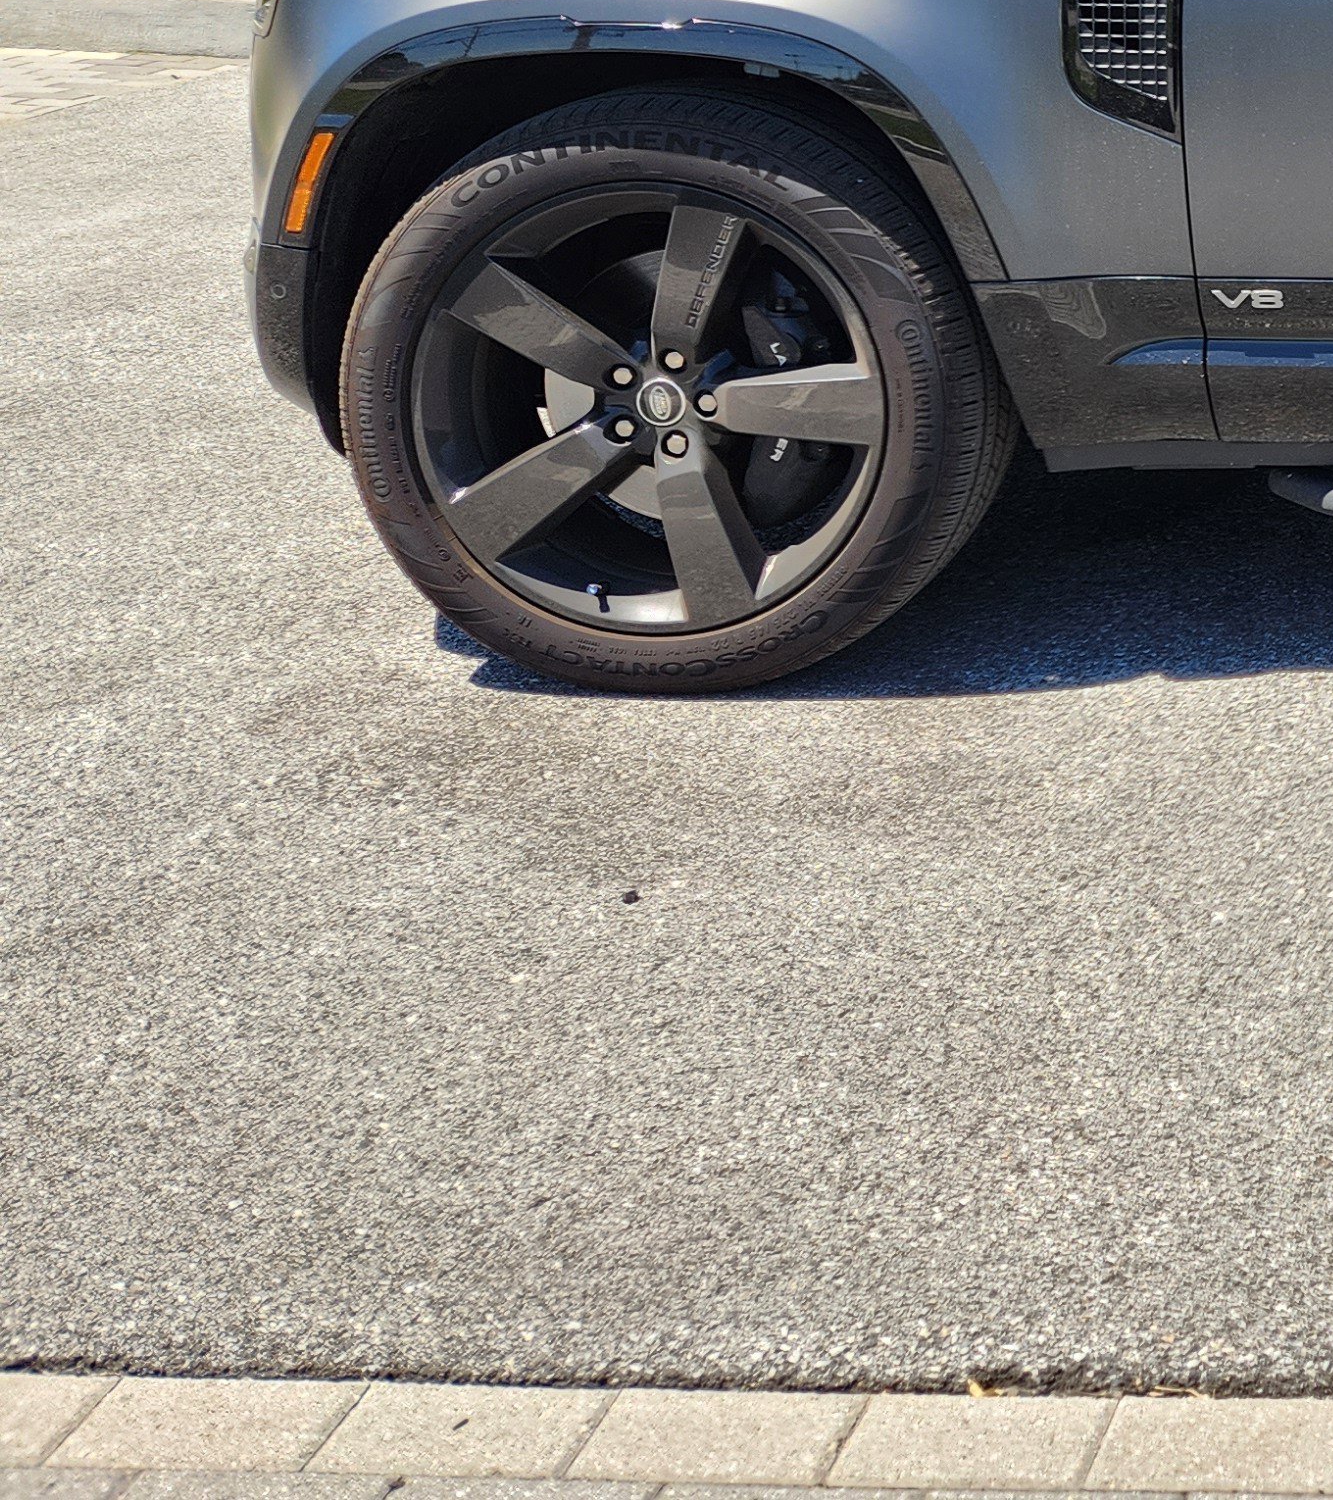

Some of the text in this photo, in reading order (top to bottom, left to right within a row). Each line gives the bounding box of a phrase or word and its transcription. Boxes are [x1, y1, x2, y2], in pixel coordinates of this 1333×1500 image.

[450, 129, 790, 208] CONTINENTAL
[684, 215, 739, 330] DEFENDER
[1210, 289, 1284, 309] V8
[356, 366, 392, 503] Continental
[893, 318, 934, 454] Continental
